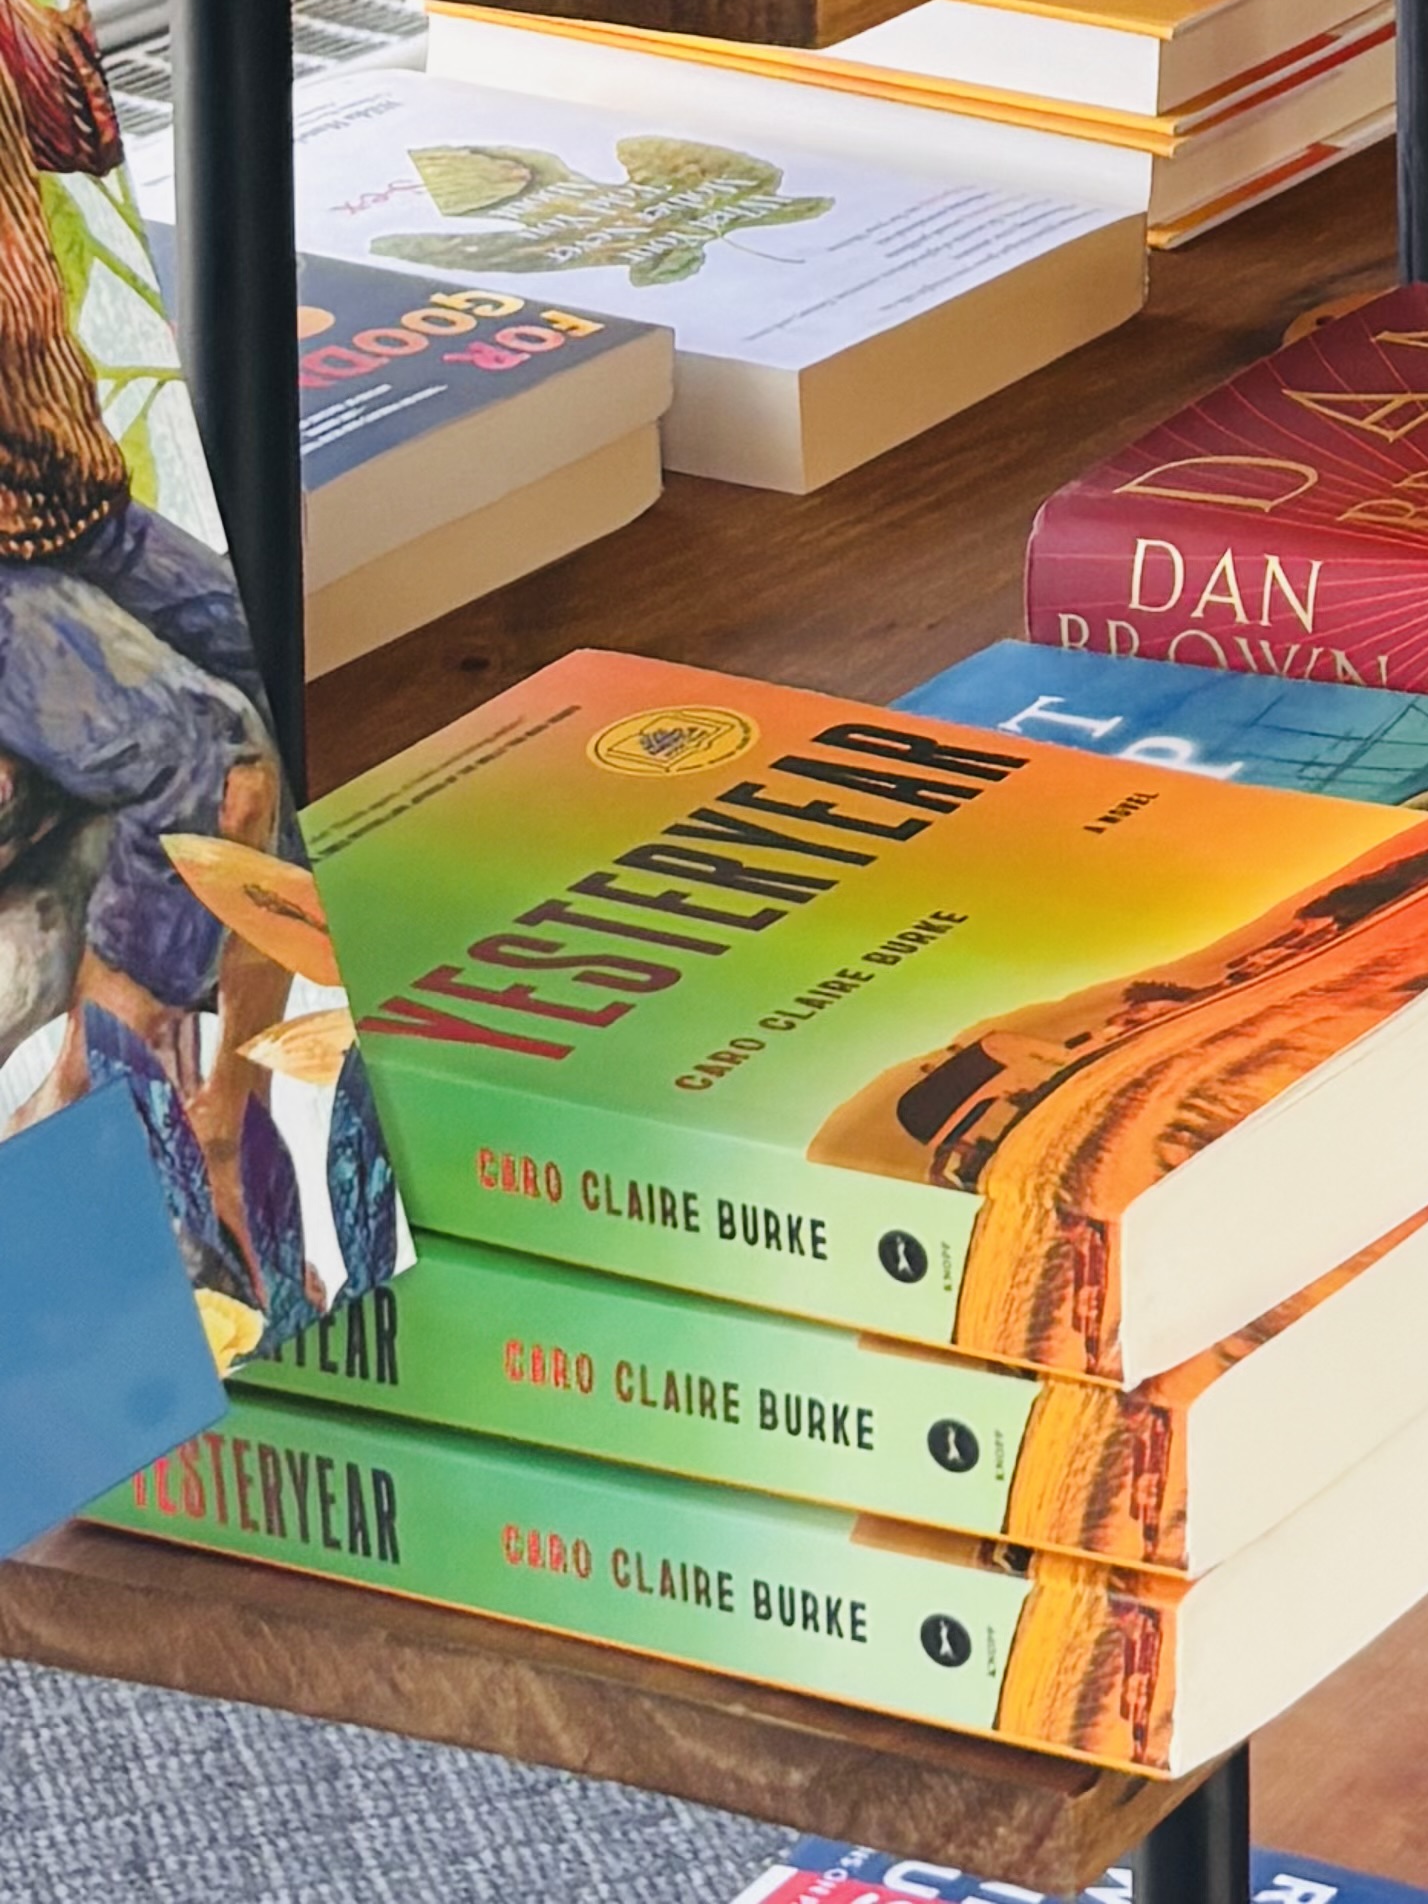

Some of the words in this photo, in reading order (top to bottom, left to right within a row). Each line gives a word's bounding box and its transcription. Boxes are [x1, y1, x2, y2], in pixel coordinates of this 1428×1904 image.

[442, 310, 606, 370] FOR
[1127, 536, 1324, 634] DAN
[1084, 819, 1102, 835] A
[1095, 791, 1161, 830] NOVEL
[358, 721, 1031, 1062] YESTERYEAR
[674, 1035, 769, 1093] CARO
[767, 966, 876, 1040] CLAIRE
[863, 907, 970, 970] BURKE
[476, 1147, 563, 1204] CARO
[580, 1178, 703, 1238] CLAIRE
[717, 1198, 830, 1261] BURKE
[502, 1338, 595, 1396] CARO
[614, 1358, 743, 1427] CLAIRE
[757, 1386, 877, 1451] BURKE
[501, 1522, 594, 1579] CARO
[610, 1544, 736, 1614] CLAIRE
[752, 1581, 869, 1643] BURKE
